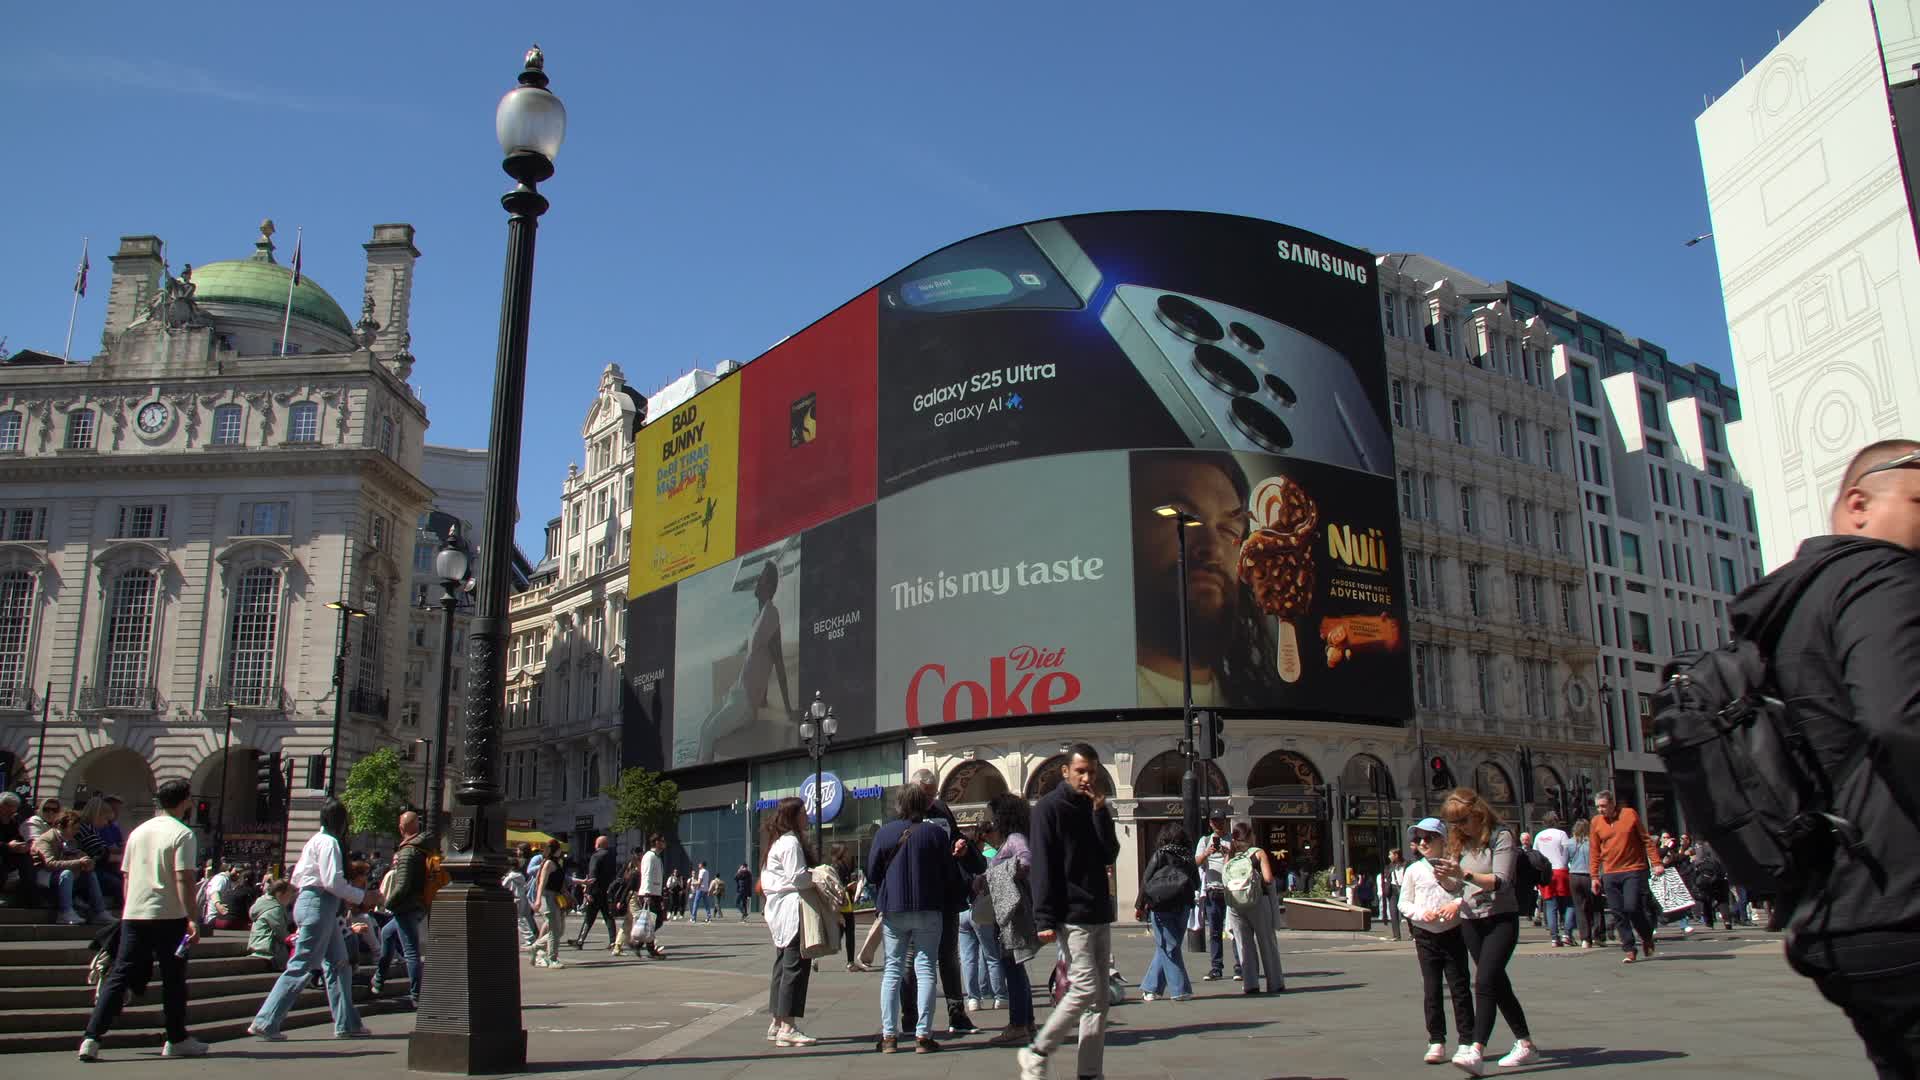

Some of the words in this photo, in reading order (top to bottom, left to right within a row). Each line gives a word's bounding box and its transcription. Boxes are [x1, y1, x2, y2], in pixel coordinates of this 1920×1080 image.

[1277, 239, 1367, 284] SAMSUNG
[913, 380, 968, 412] Galaxy
[970, 369, 1002, 392] S25
[1006, 363, 1056, 384] Ultra
[672, 405, 697, 435] BAD
[934, 403, 984, 427] Galaxy
[988, 397, 1002, 413] AI
[662, 421, 705, 462] BUNNY
[890, 577, 935, 611] This
[938, 570, 958, 600] is
[962, 567, 1010, 595] my
[1015, 554, 1104, 586] taste
[1330, 587, 1392, 605] ADVENTURE
[1331, 578, 1356, 588] CHOOSE
[1357, 582, 1372, 590] YOUR
[813, 610, 860, 634] BECKHAM
[828, 627, 845, 640] BOSS
[1008, 645, 1067, 671] Diet
[633, 668, 665, 687] BECKHAM
[905, 655, 1081, 730] Coke
[852, 784, 883, 800] beauty
